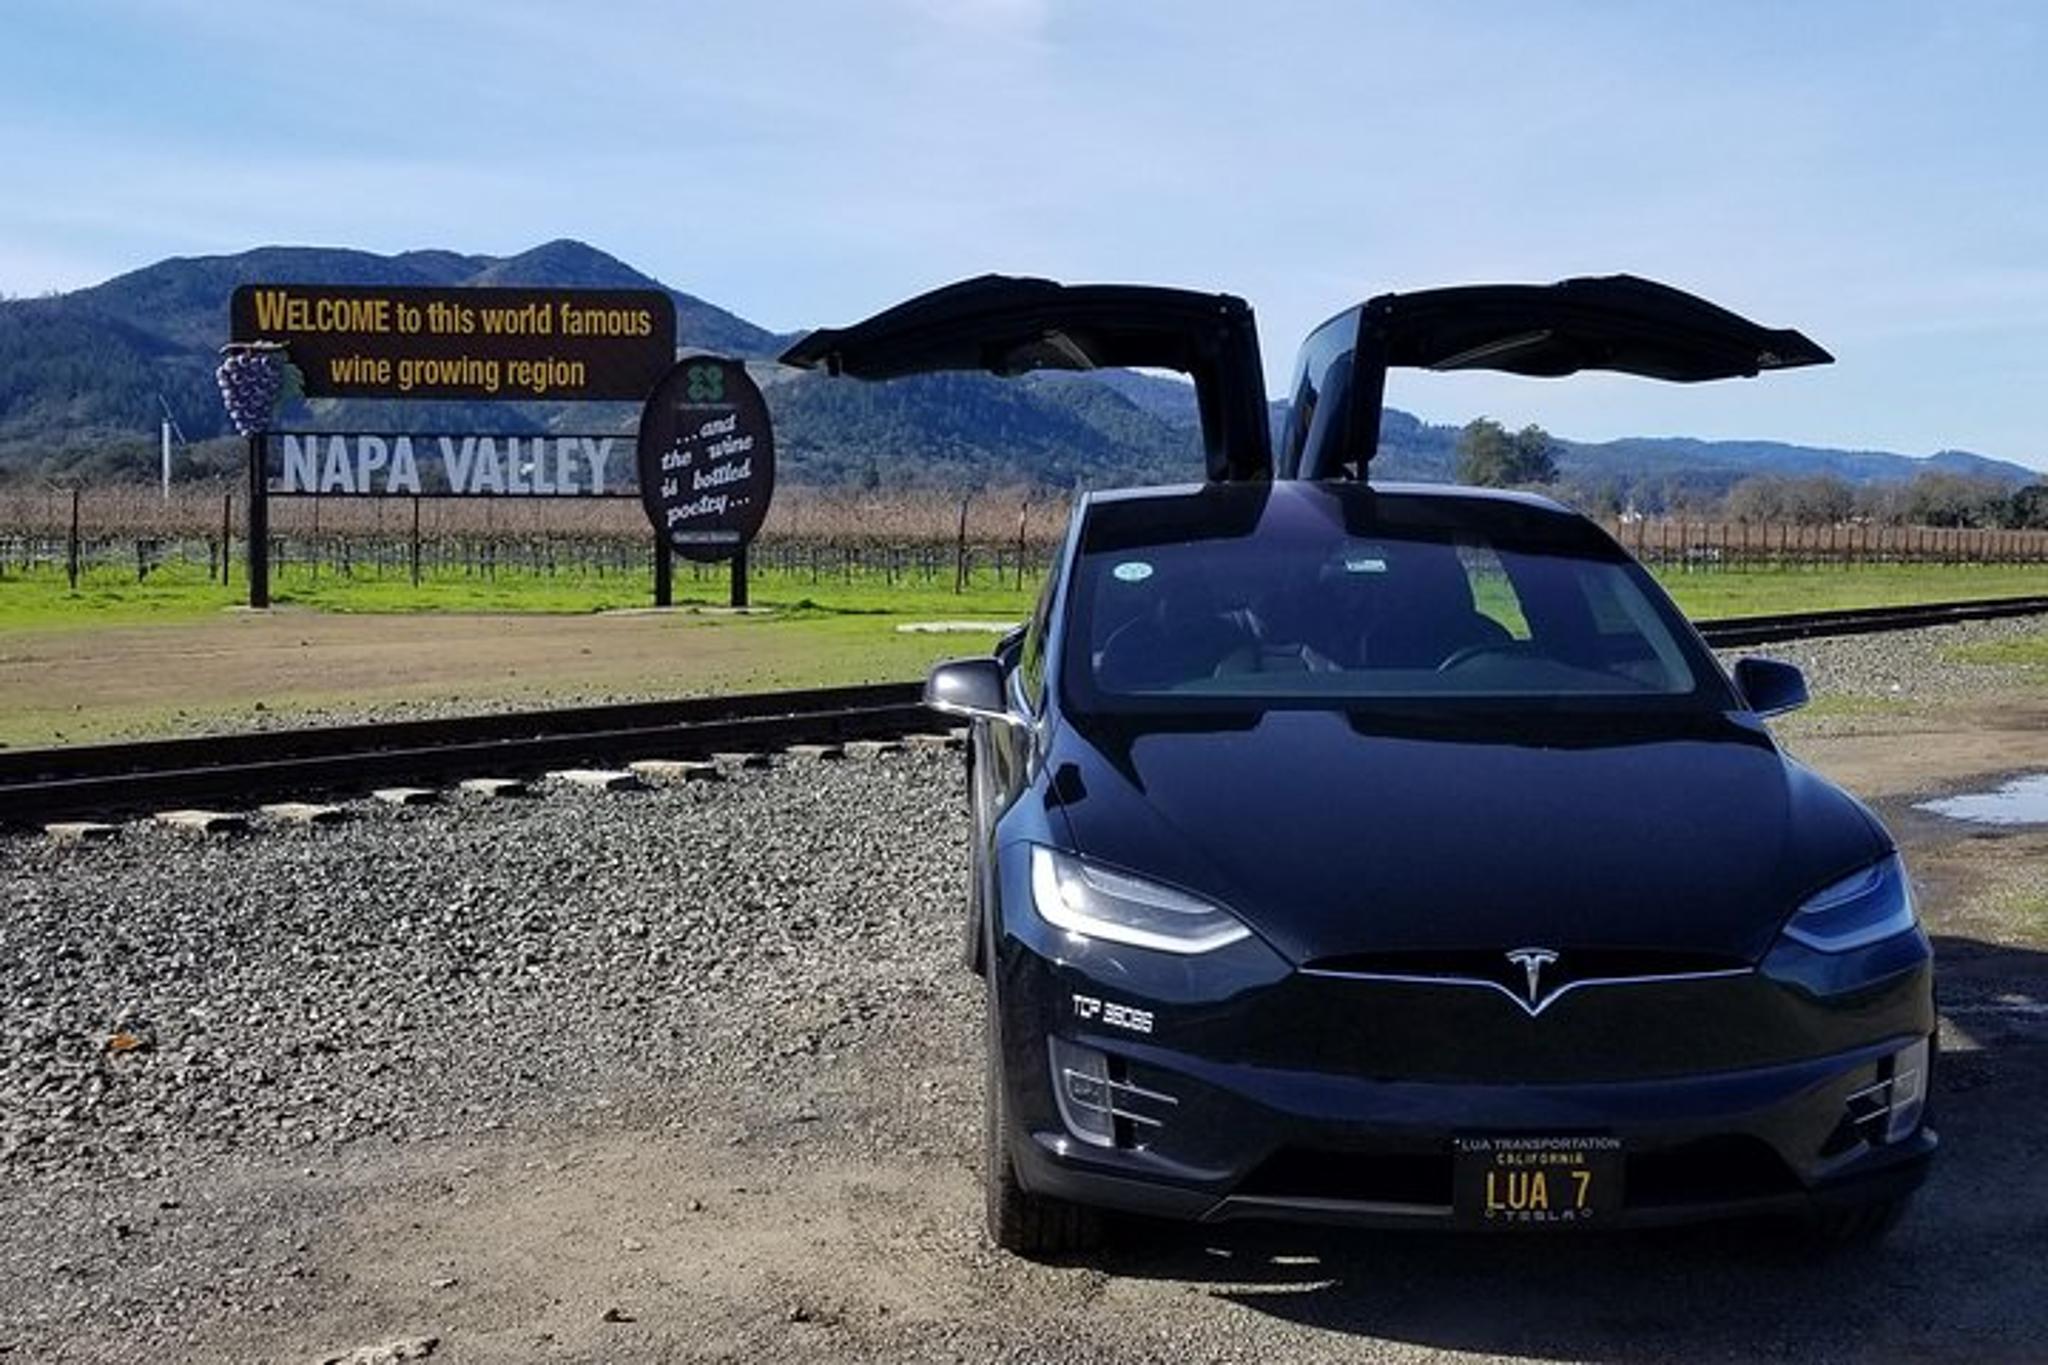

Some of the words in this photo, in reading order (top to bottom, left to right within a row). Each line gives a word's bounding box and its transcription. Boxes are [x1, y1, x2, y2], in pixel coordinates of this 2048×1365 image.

[255, 291, 391, 332] WELCOME
[398, 303, 422, 333] to
[427, 301, 475, 335] this
[482, 302, 553, 336] world
[560, 303, 653, 337] famous
[331, 355, 391, 385] wine
[400, 356, 500, 390] growing
[508, 357, 586, 391] region
[283, 435, 421, 494] NAPA
[438, 436, 615, 495] VALLEY
[661, 448, 693, 471] the
[707, 435, 754, 460] wine
[660, 477, 678, 498] is
[693, 458, 752, 491] bottled
[1072, 994, 1101, 1019] TCP
[1461, 1138, 1491, 1150] LUA
[1494, 1136, 1622, 1150] TRANSPORTATION
[1496, 1152, 1584, 1165] CALIFORNIA
[1486, 1171, 1549, 1210] LUA
[1571, 1171, 1591, 1209] 7
[1504, 1210, 1575, 1221] TESLA
